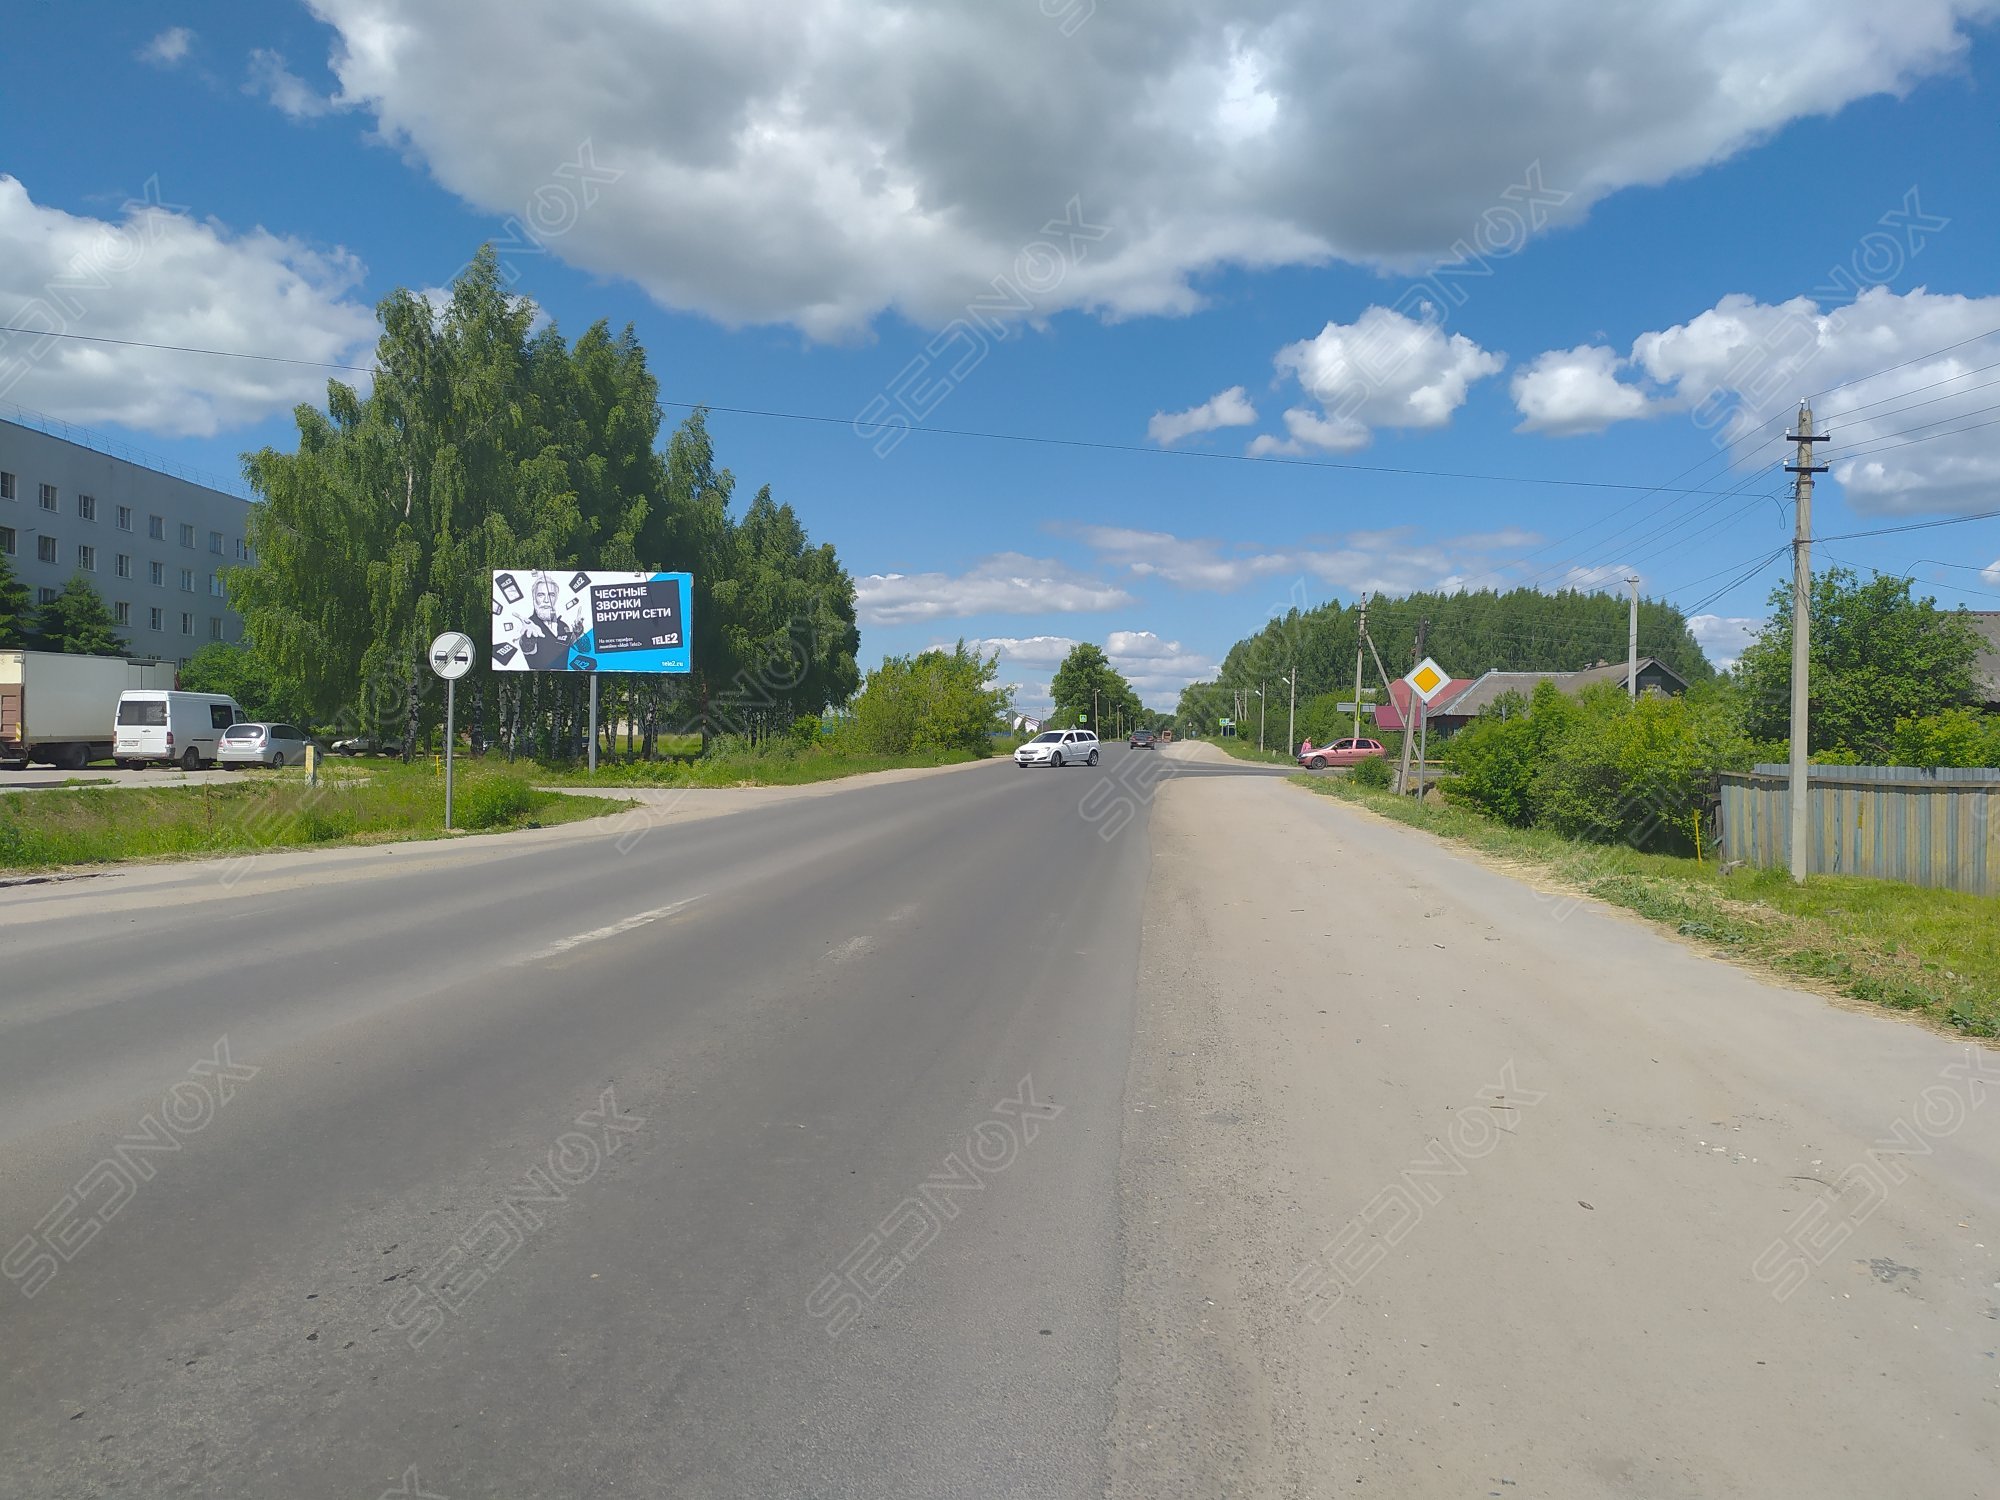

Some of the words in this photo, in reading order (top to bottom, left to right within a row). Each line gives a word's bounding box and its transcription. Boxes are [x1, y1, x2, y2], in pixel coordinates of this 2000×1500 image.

[594, 586, 648, 599] ЧЕСТНЫЕ
[596, 598, 641, 611] ЗВОНКИ
[596, 610, 641, 622] ВНУТРИ
[642, 607, 672, 619] СЕТИ
[651, 632, 679, 645] TELE2
